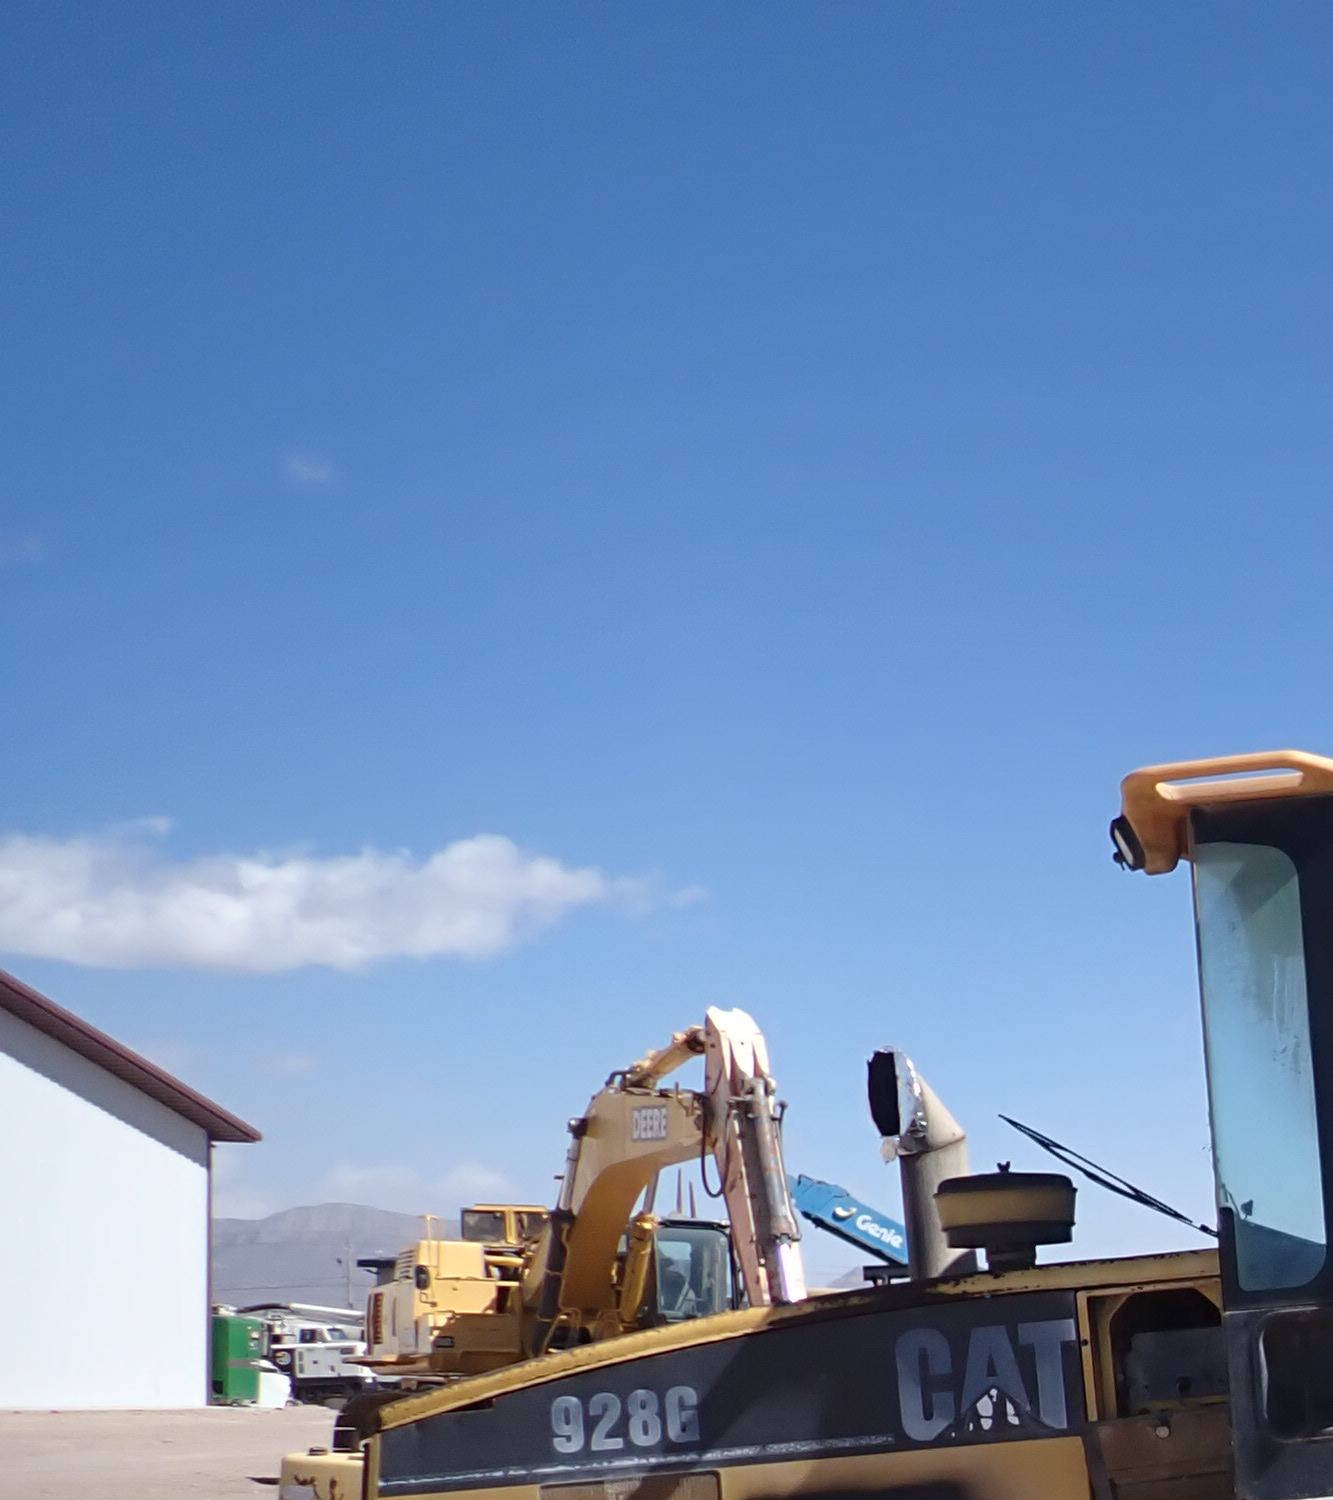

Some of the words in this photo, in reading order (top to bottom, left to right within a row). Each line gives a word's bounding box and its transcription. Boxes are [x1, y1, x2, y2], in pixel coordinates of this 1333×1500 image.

[632, 1107, 667, 1140] DEERE
[856, 1214, 903, 1249] Genie
[895, 1318, 1077, 1441] CAT
[551, 1385, 700, 1453] 928G
